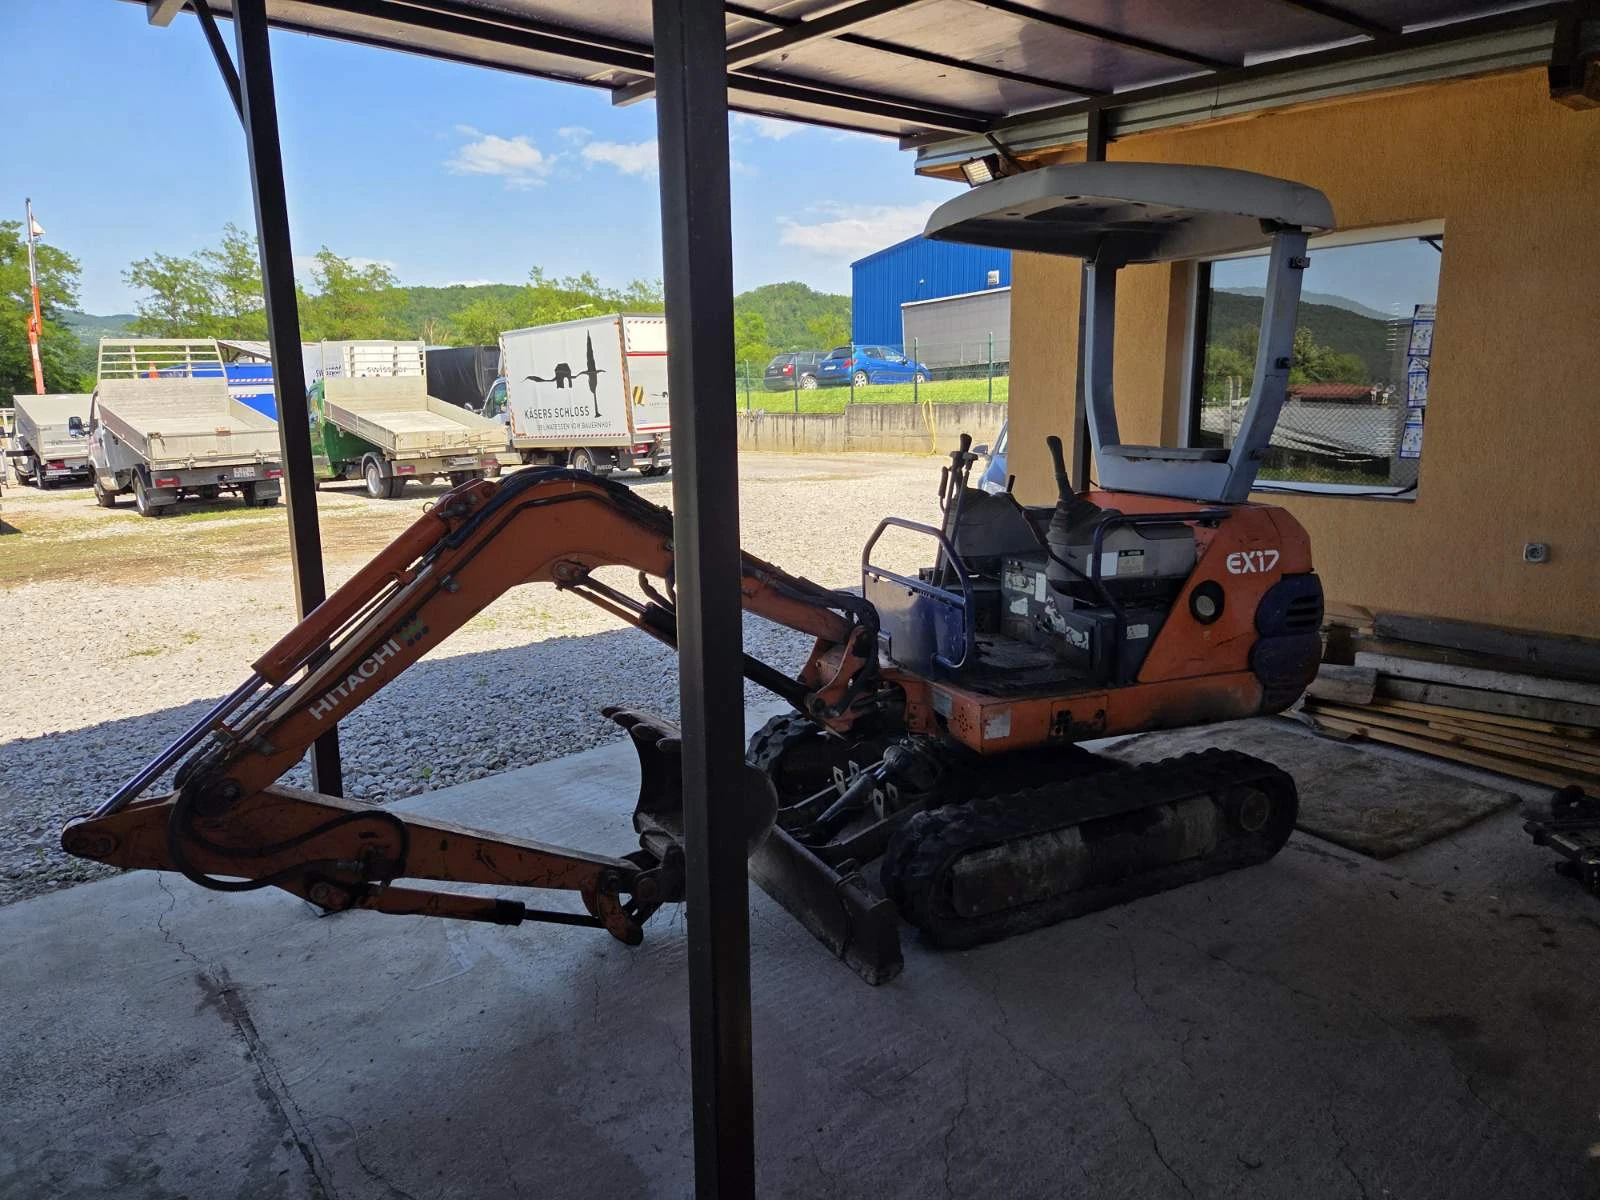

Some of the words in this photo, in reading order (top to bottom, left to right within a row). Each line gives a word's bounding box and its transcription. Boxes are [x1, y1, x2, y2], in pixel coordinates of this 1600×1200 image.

[367, 364, 408, 373] swissor
[555, 406, 590, 418] SCHLOSS
[308, 639, 402, 720] HITACHI
